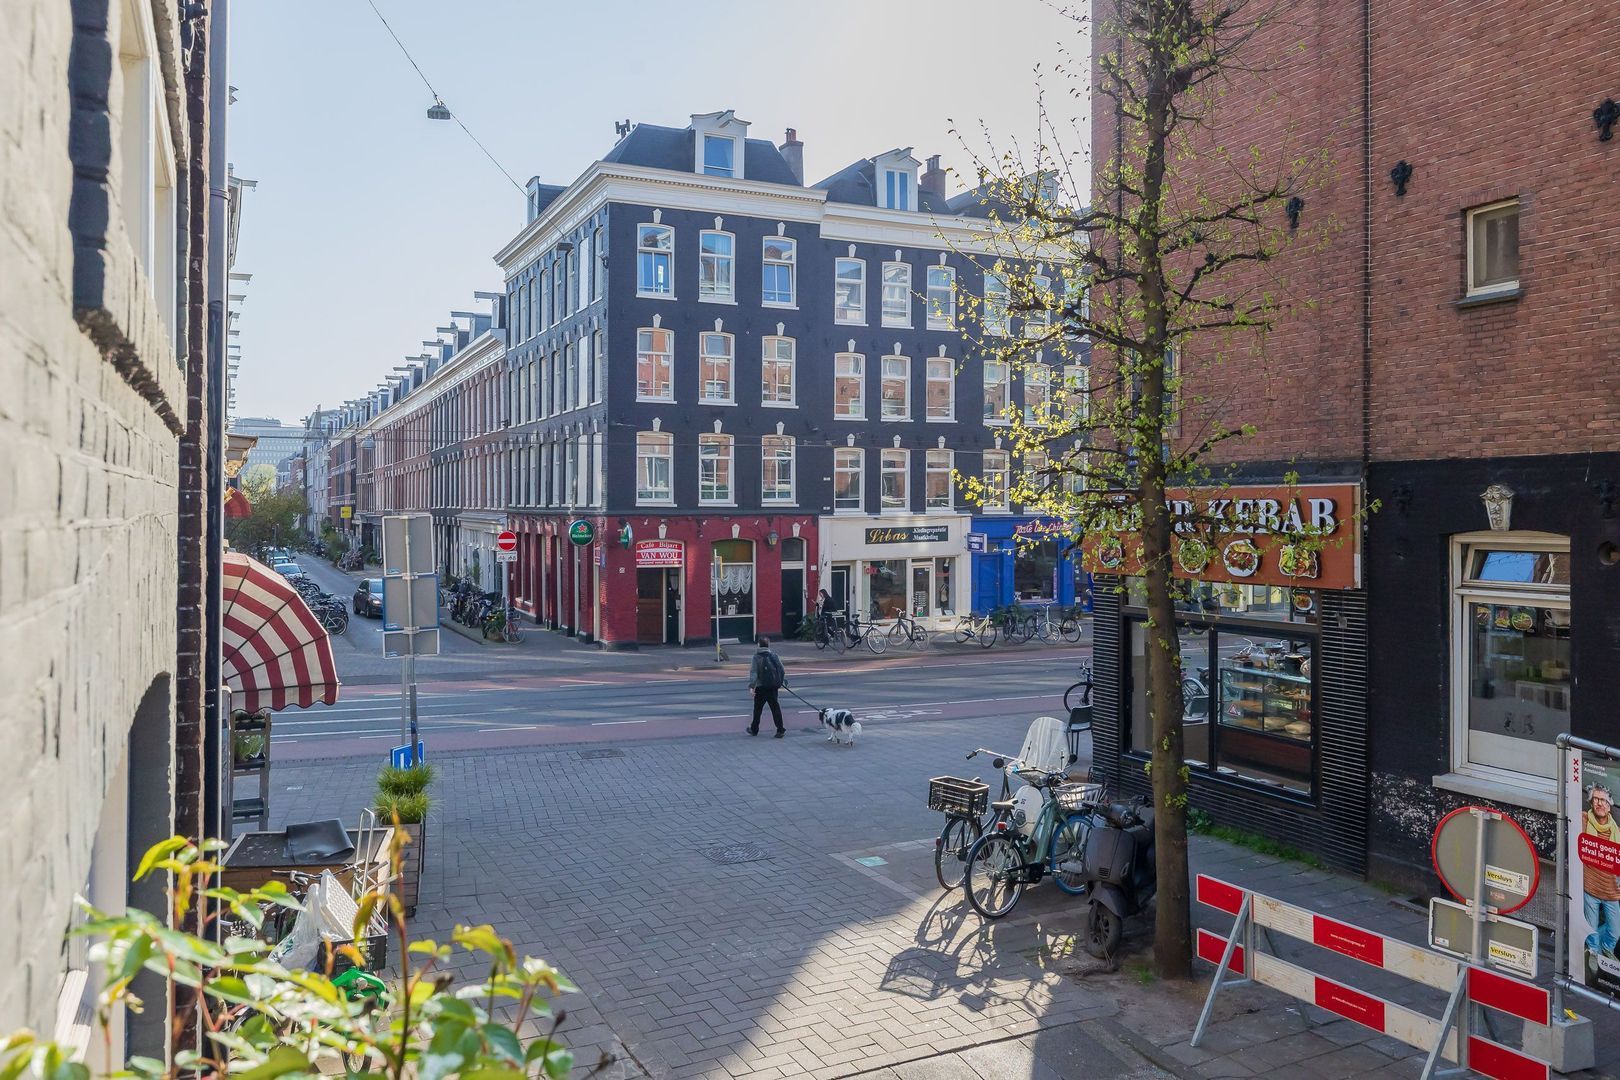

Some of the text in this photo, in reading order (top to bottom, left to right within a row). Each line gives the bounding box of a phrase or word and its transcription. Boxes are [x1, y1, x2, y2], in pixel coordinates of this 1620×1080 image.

[1207, 498, 1335, 535] KEBAB
[1581, 837, 1618, 855] Joost gooit
[1581, 846, 1597, 857] afval
[1597, 850, 1605, 859] in
[1605, 853, 1615, 862] de
[1486, 871, 1513, 884] Versluys
[1490, 946, 1517, 960] Versluys
[1600, 959, 1608, 967] Zo
